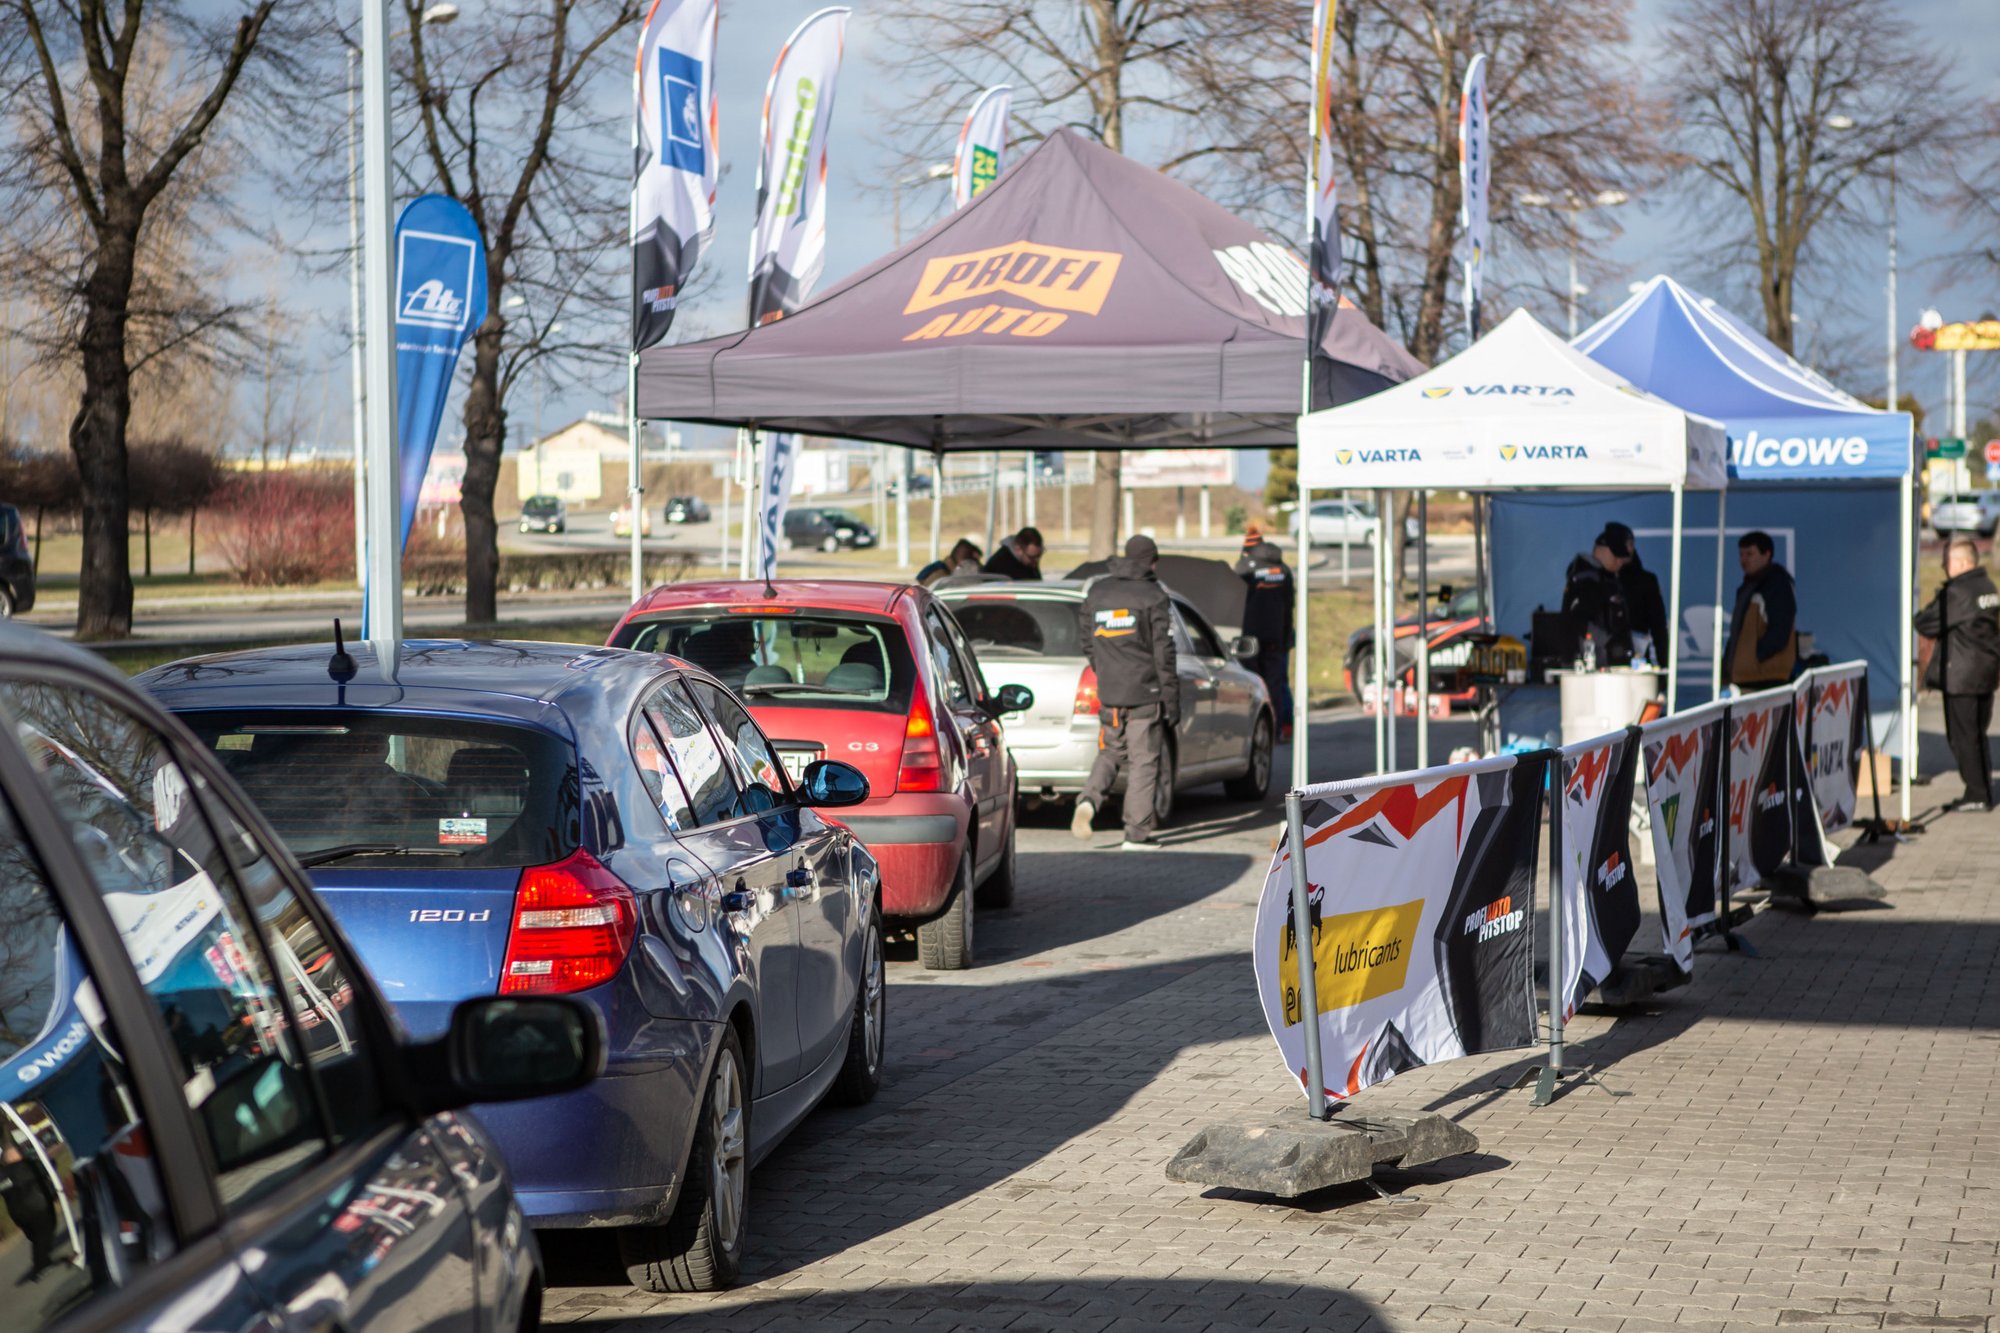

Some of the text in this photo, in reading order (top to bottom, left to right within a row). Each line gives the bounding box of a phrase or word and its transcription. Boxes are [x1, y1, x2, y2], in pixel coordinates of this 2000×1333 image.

[776, 77, 817, 217] valeo
[929, 252, 1101, 297] PROFI
[902, 304, 1069, 341] AUTO
[1463, 385, 1575, 397] VARTA
[1358, 449, 1421, 463] VARTA
[1523, 446, 1588, 460] VARTA
[764, 432, 791, 568] VART
[848, 741, 879, 752] C3
[1479, 910, 1523, 943] PITSTOP
[1334, 938, 1402, 975] lubricants
